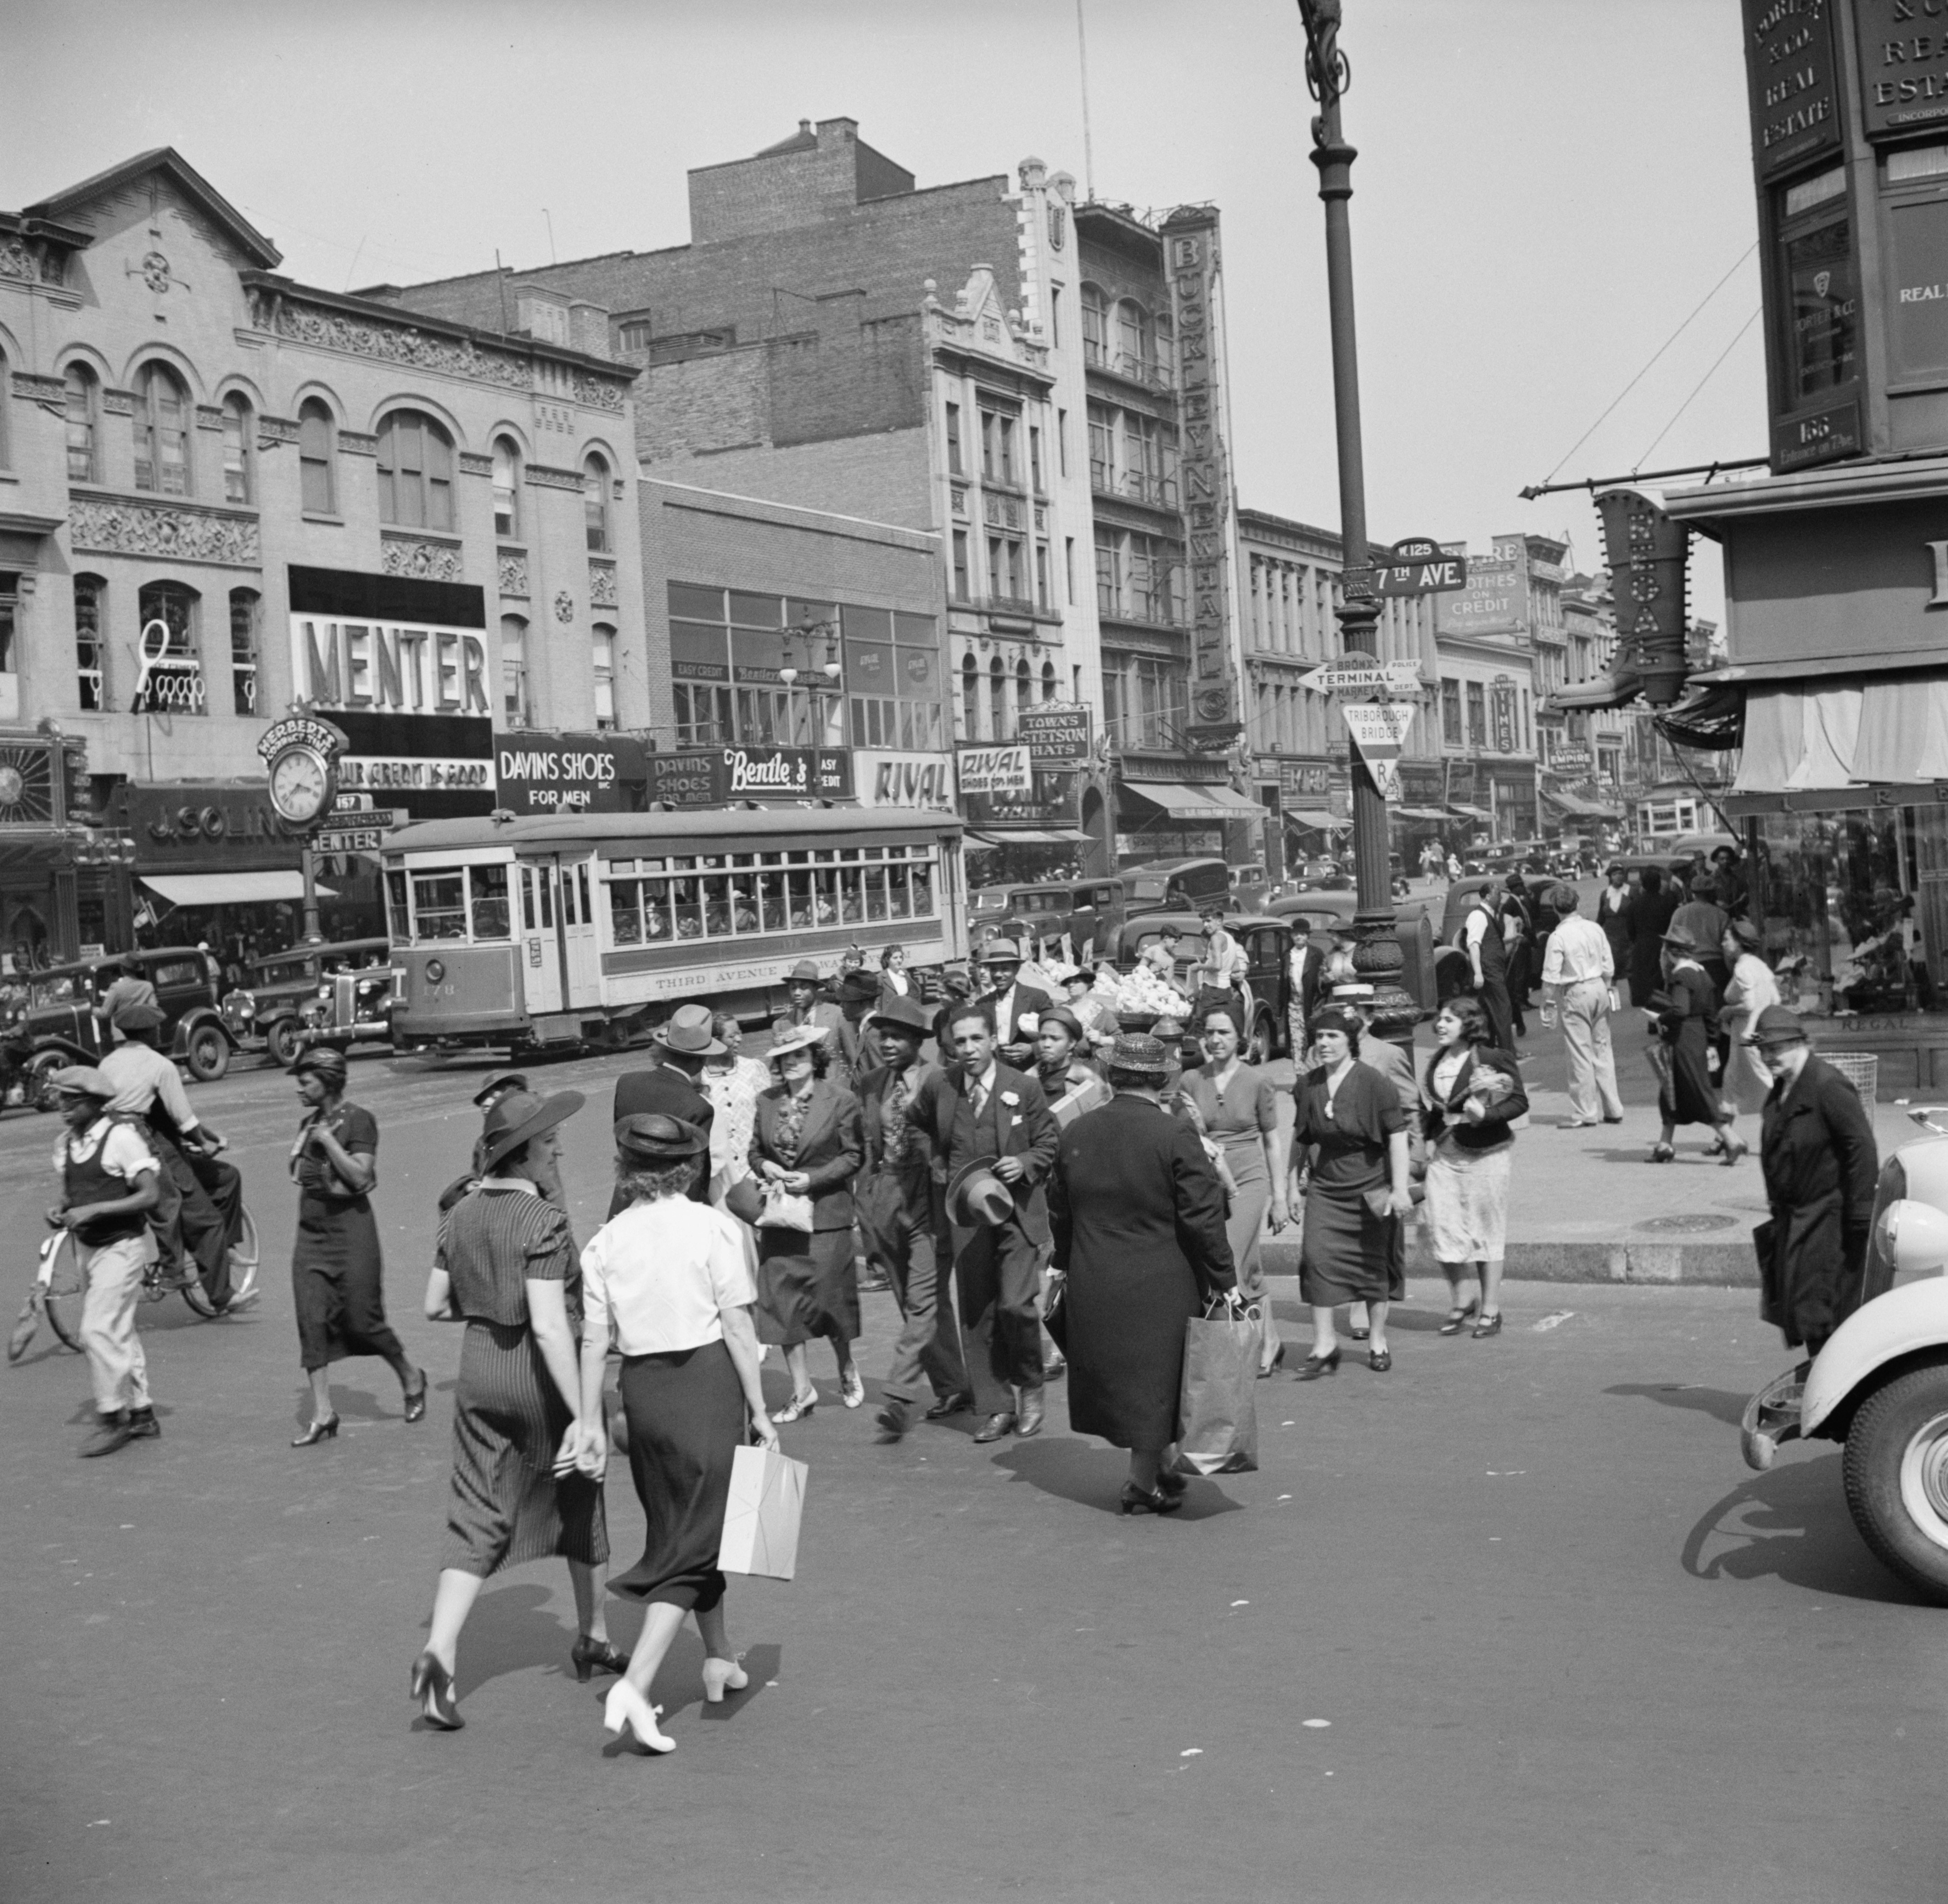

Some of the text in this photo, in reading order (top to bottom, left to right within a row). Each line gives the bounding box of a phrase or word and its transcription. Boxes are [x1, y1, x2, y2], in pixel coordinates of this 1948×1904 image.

[1767, 67, 1819, 106] REAL
[1764, 97, 1830, 147] ESTATE
[1898, 108, 1948, 122] INCORPO
[1900, 285, 1943, 303] REAL
[1419, 562, 1461, 587] AVE.
[1465, 574, 1517, 590] OTHES
[1472, 591, 1490, 599] ON
[1628, 514, 1661, 666] REGAL
[1452, 598, 1509, 615] CREDIT
[299, 621, 490, 712] MENTER
[1337, 660, 1374, 671] BRONX
[1318, 672, 1394, 685] TERMINAL
[1337, 686, 1376, 697] MARKET
[1026, 716, 1079, 728] TOWN'S
[1349, 710, 1408, 722] TRIBOROUGH
[1498, 691, 1510, 750] TIMES
[1020, 728, 1087, 744] STETSON
[1362, 727, 1398, 739] BRIDGE
[1032, 745, 1076, 755] HATS
[501, 751, 615, 780] DAVINS SHOES
[821, 759, 837, 771] ASY
[961, 751, 1024, 774] RIVAL
[813, 775, 841, 787] EDIT
[1377, 764, 1387, 783] R
[656, 777, 711, 792] SHOES
[875, 762, 949, 805] RIVAL
[336, 796, 355, 809] 157
[530, 790, 590, 805] FOR MEN
[391, 968, 407, 1002] T
[656, 976, 705, 989] THIRD
[716, 966, 777, 981] AVENUE
[424, 985, 454, 996] 178
